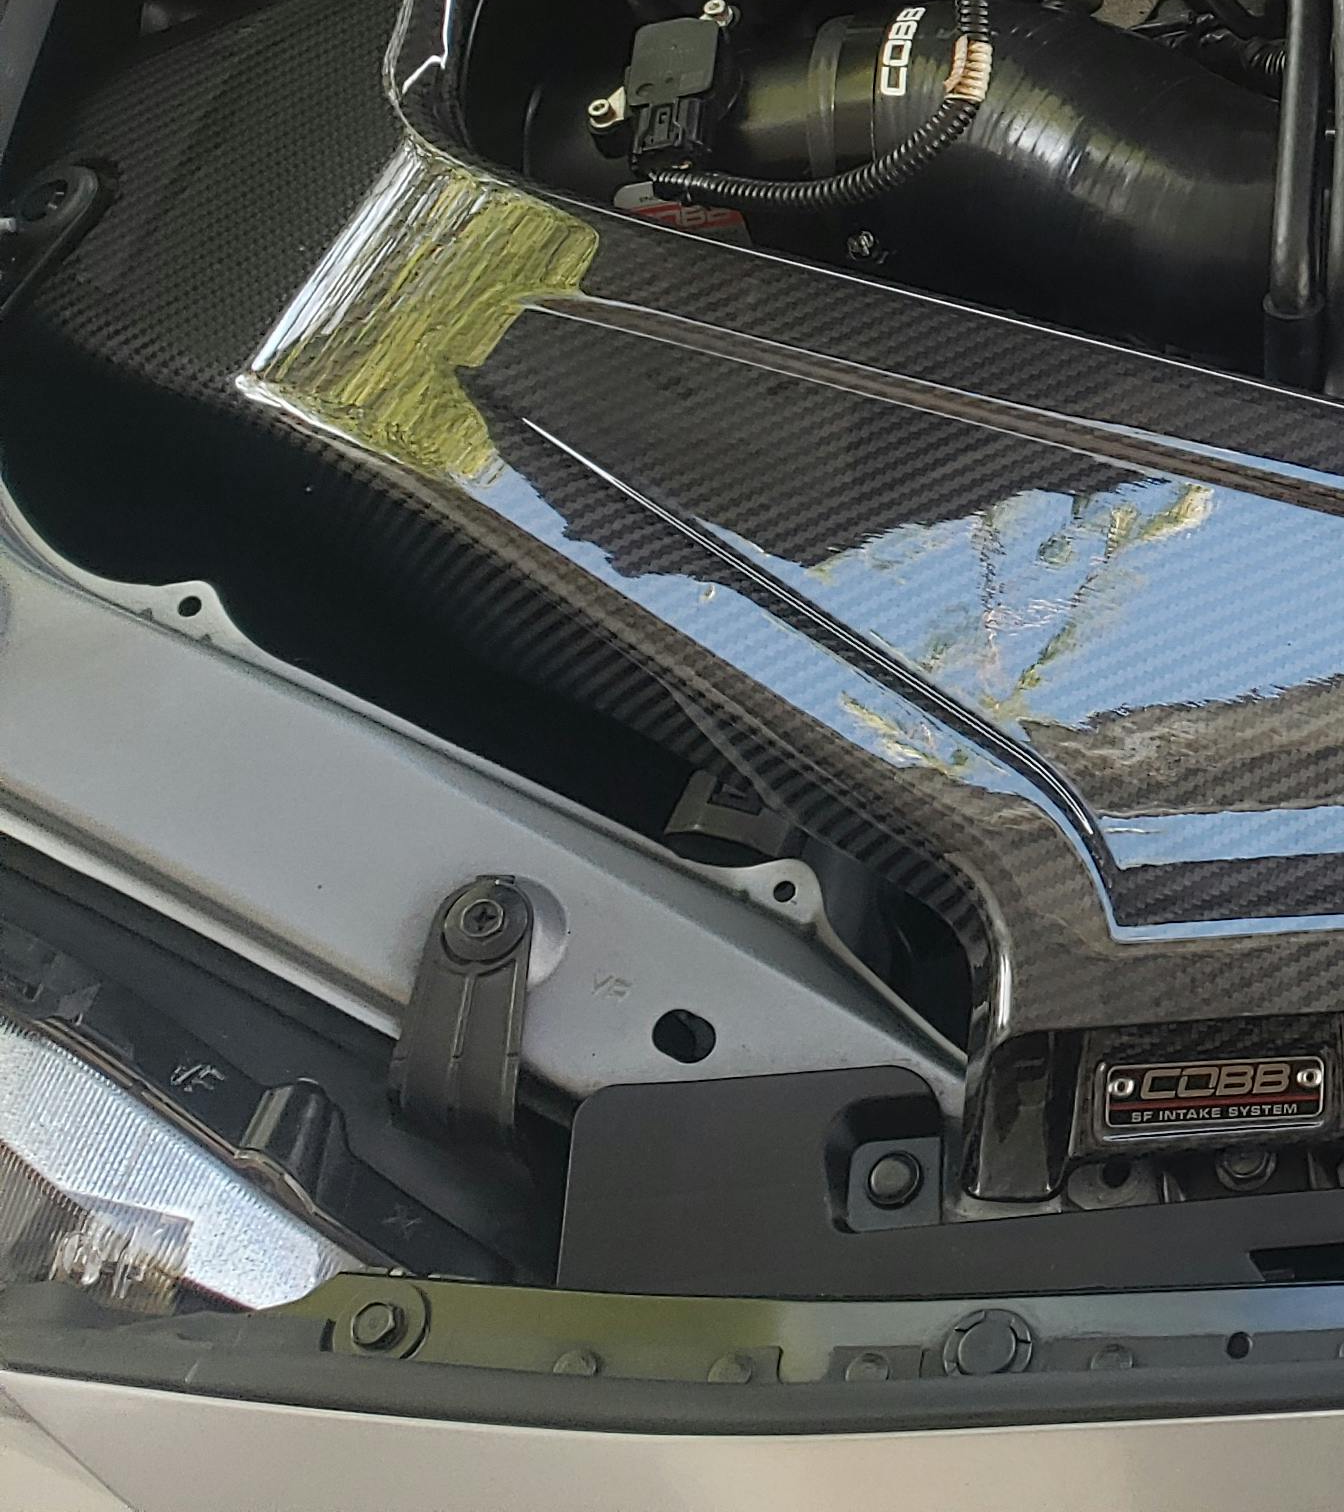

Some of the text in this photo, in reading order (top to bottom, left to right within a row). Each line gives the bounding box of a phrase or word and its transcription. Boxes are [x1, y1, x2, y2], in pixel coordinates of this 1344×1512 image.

[880, 6, 927, 97] COBB
[1140, 1063, 1291, 1100] COBB
[1131, 1103, 1298, 1123] SF INTAKE SYSTEM
